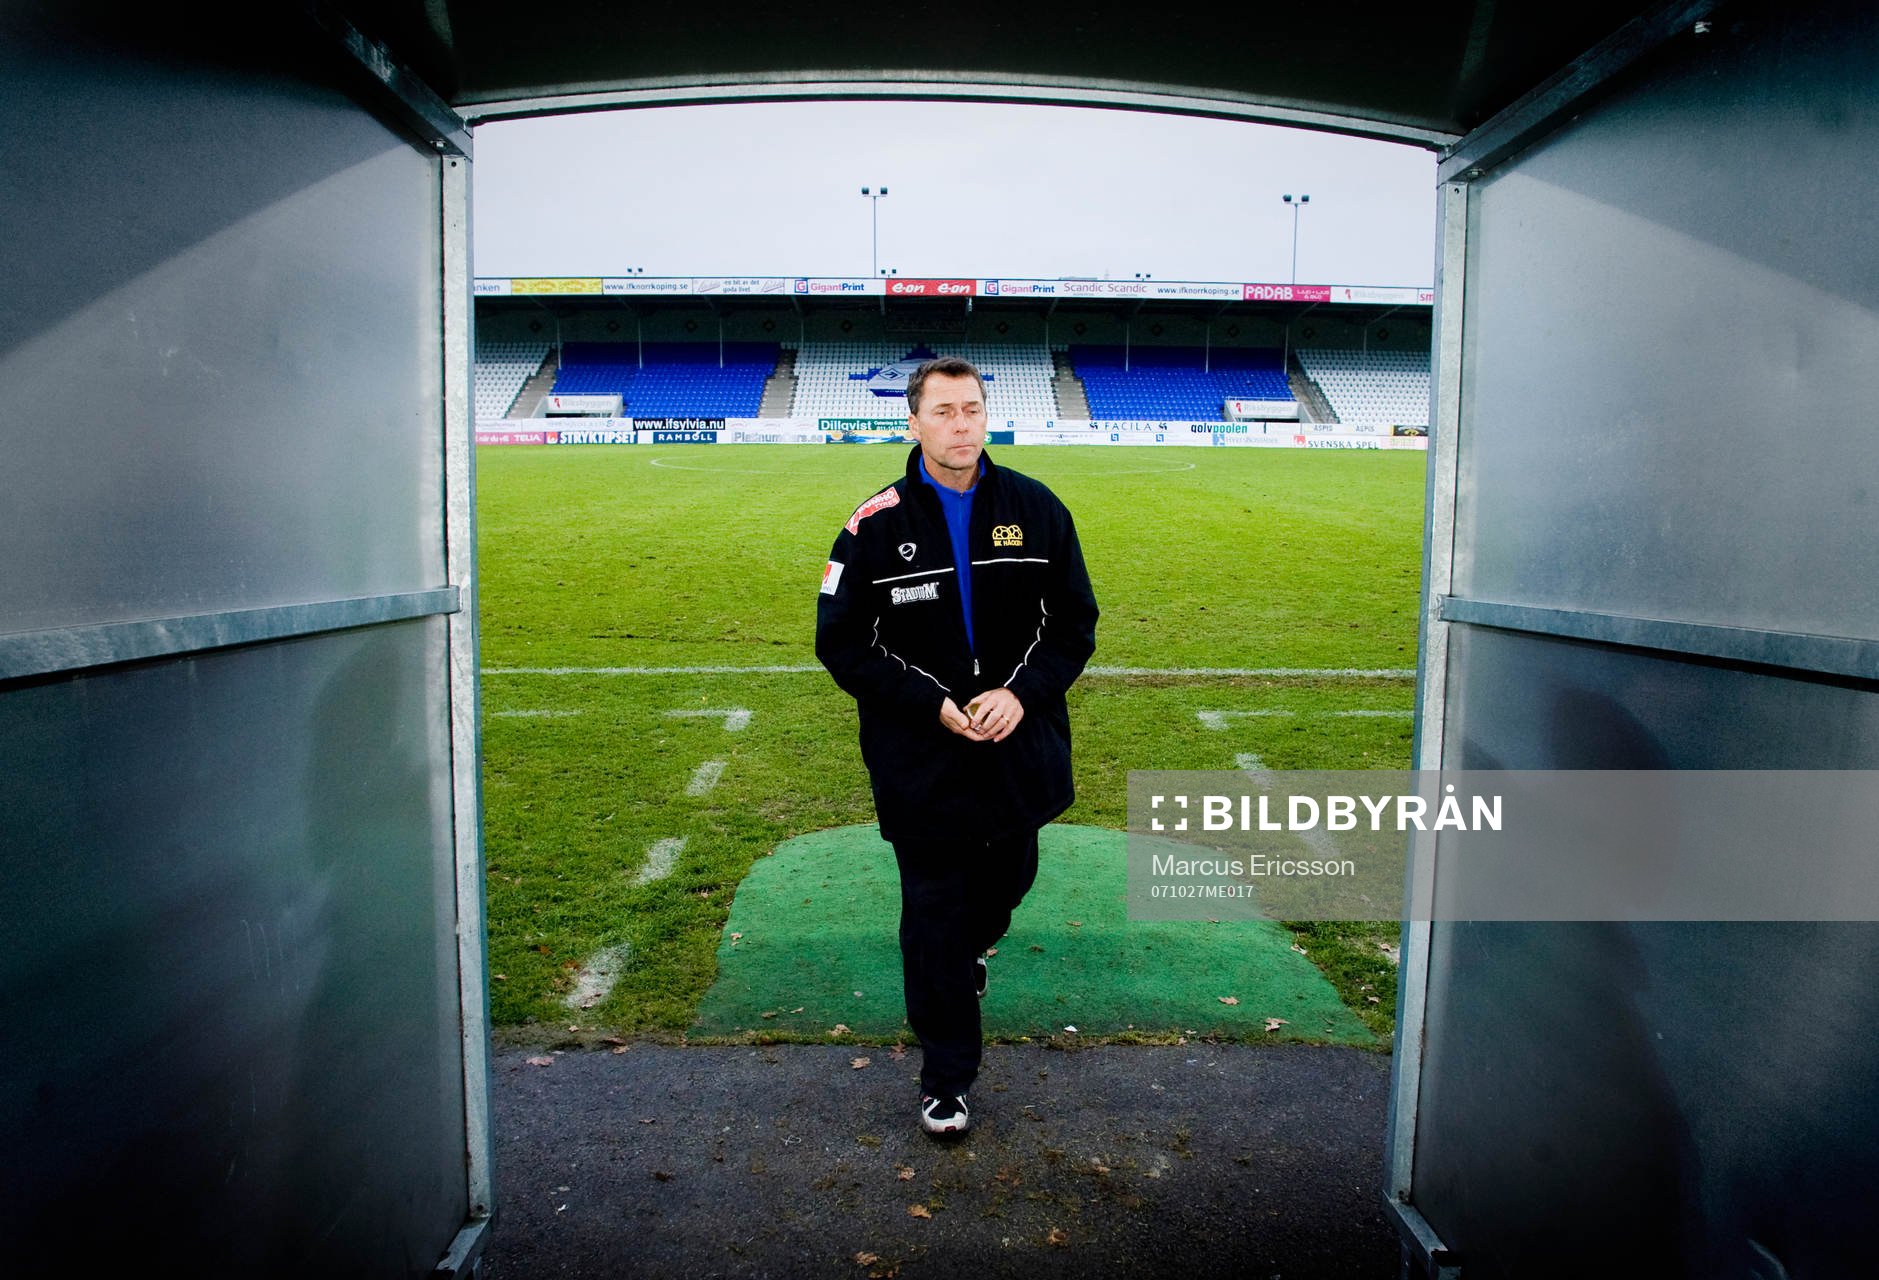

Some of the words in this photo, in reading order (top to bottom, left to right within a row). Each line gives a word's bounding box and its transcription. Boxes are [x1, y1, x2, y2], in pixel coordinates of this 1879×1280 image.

[810, 282, 865, 293] GigantPrint
[1001, 284, 1055, 294] GigantPrint
[1063, 283, 1103, 293] Scandic
[1107, 283, 1147, 293] Scandic
[1245, 285, 1293, 301] PADAB
[634, 419, 724, 430] www.ifsylvia.nu
[1104, 422, 1152, 432] FACILA
[559, 431, 636, 444] STRYKTIPSET
[1308, 440, 1353, 449] SVENSKA
[1356, 441, 1378, 449] SPEL
